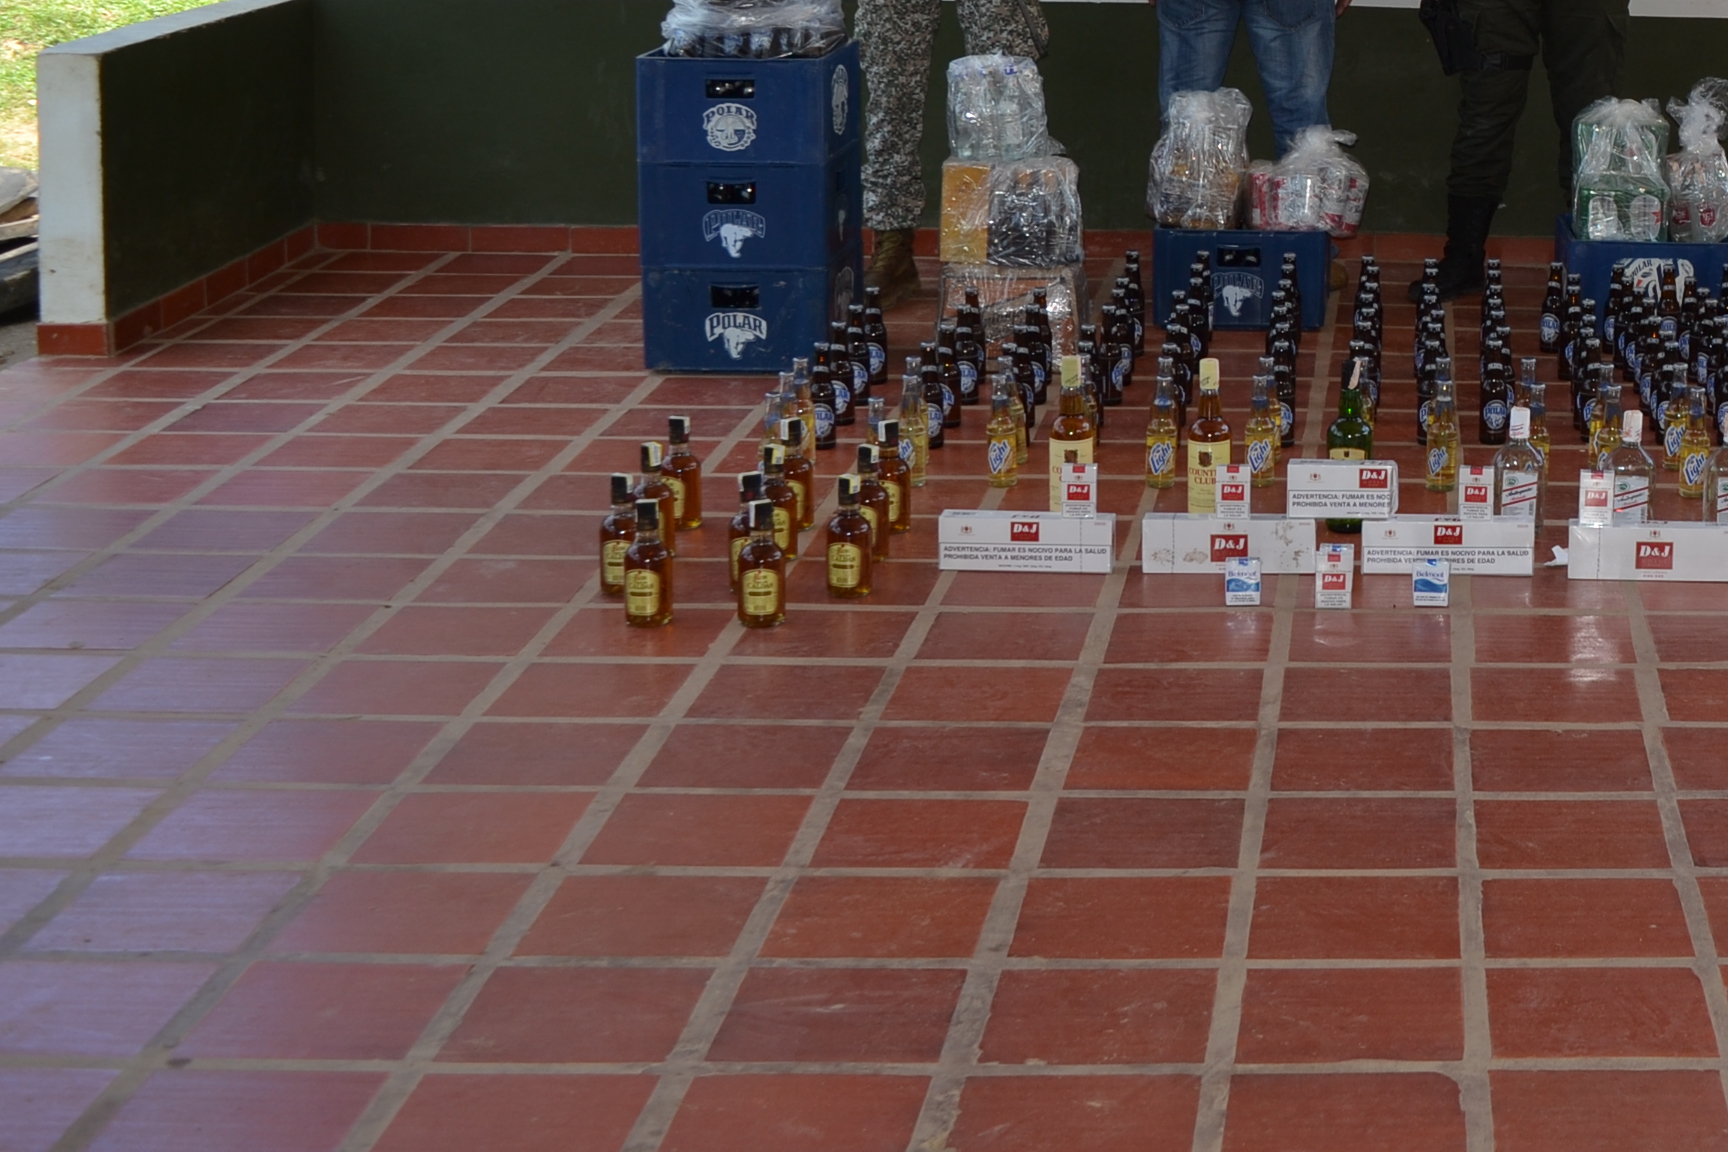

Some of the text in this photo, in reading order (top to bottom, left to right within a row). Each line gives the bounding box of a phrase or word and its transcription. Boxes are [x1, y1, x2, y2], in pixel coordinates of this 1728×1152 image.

[704, 104, 755, 129] POLAR
[708, 313, 764, 338] POLAR
[1361, 470, 1386, 480] D&J
[1069, 485, 1089, 494] D&J
[1223, 485, 1243, 494] D&J
[1466, 487, 1486, 496] D&J
[1586, 491, 1607, 499] D&J
[1012, 523, 1038, 534] D&J
[1436, 526, 1461, 537] D&J
[1213, 537, 1246, 550] D&J
[1639, 545, 1671, 558] D&J
[1324, 574, 1344, 583] D&J
